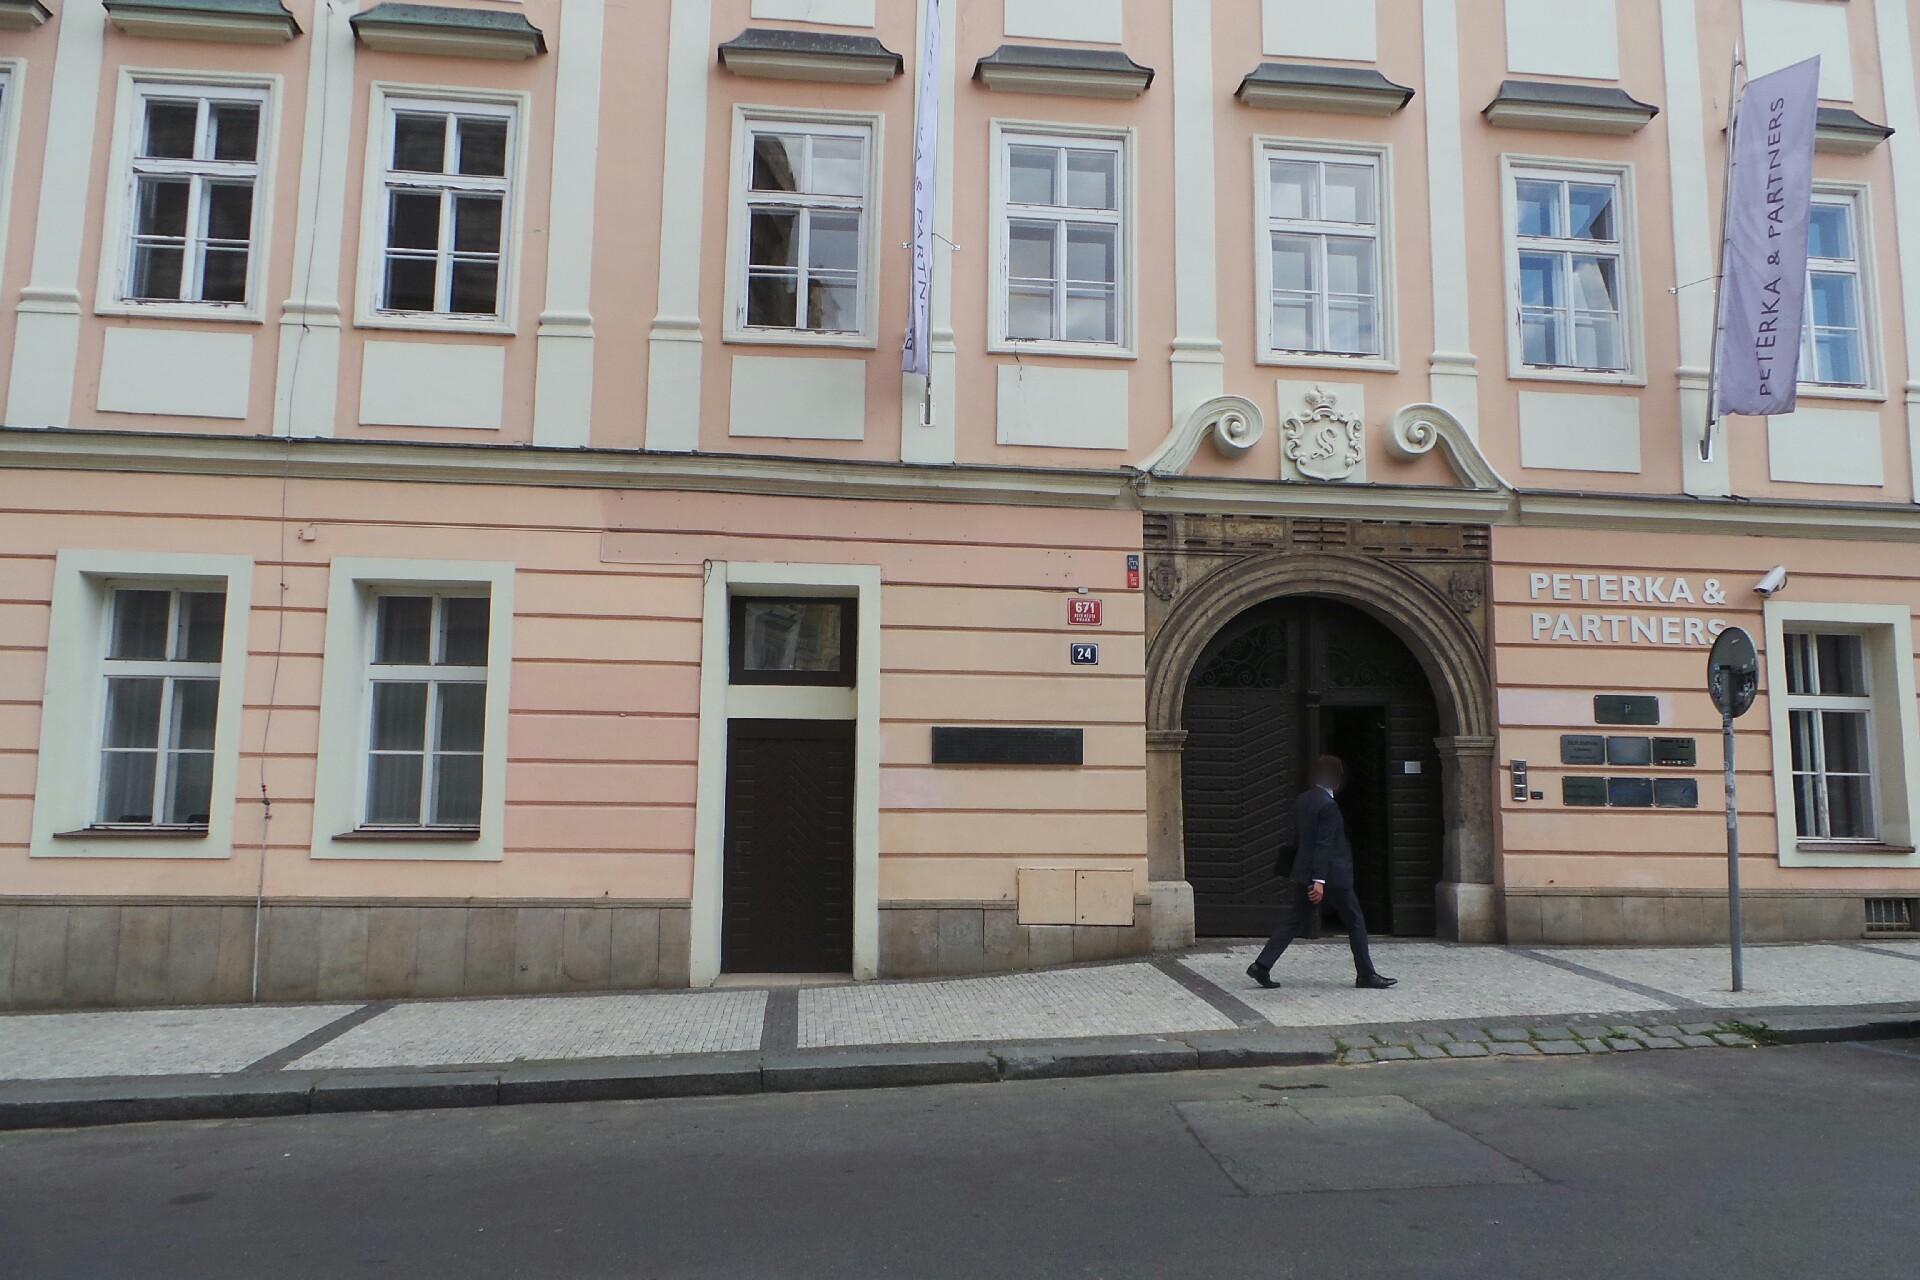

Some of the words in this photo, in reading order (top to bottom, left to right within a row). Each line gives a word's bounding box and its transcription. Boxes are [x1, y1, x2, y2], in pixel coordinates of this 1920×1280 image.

[1767, 97, 1785, 239] PARTNERS
[1767, 250, 1780, 265] &
[1756, 278, 1781, 396] PETERKA
[1530, 573, 1696, 603] PETERKA
[1702, 578, 1727, 605] &
[1075, 601, 1095, 614] 671
[1531, 612, 1727, 645] PARTNERS
[1077, 647, 1092, 660] 24
